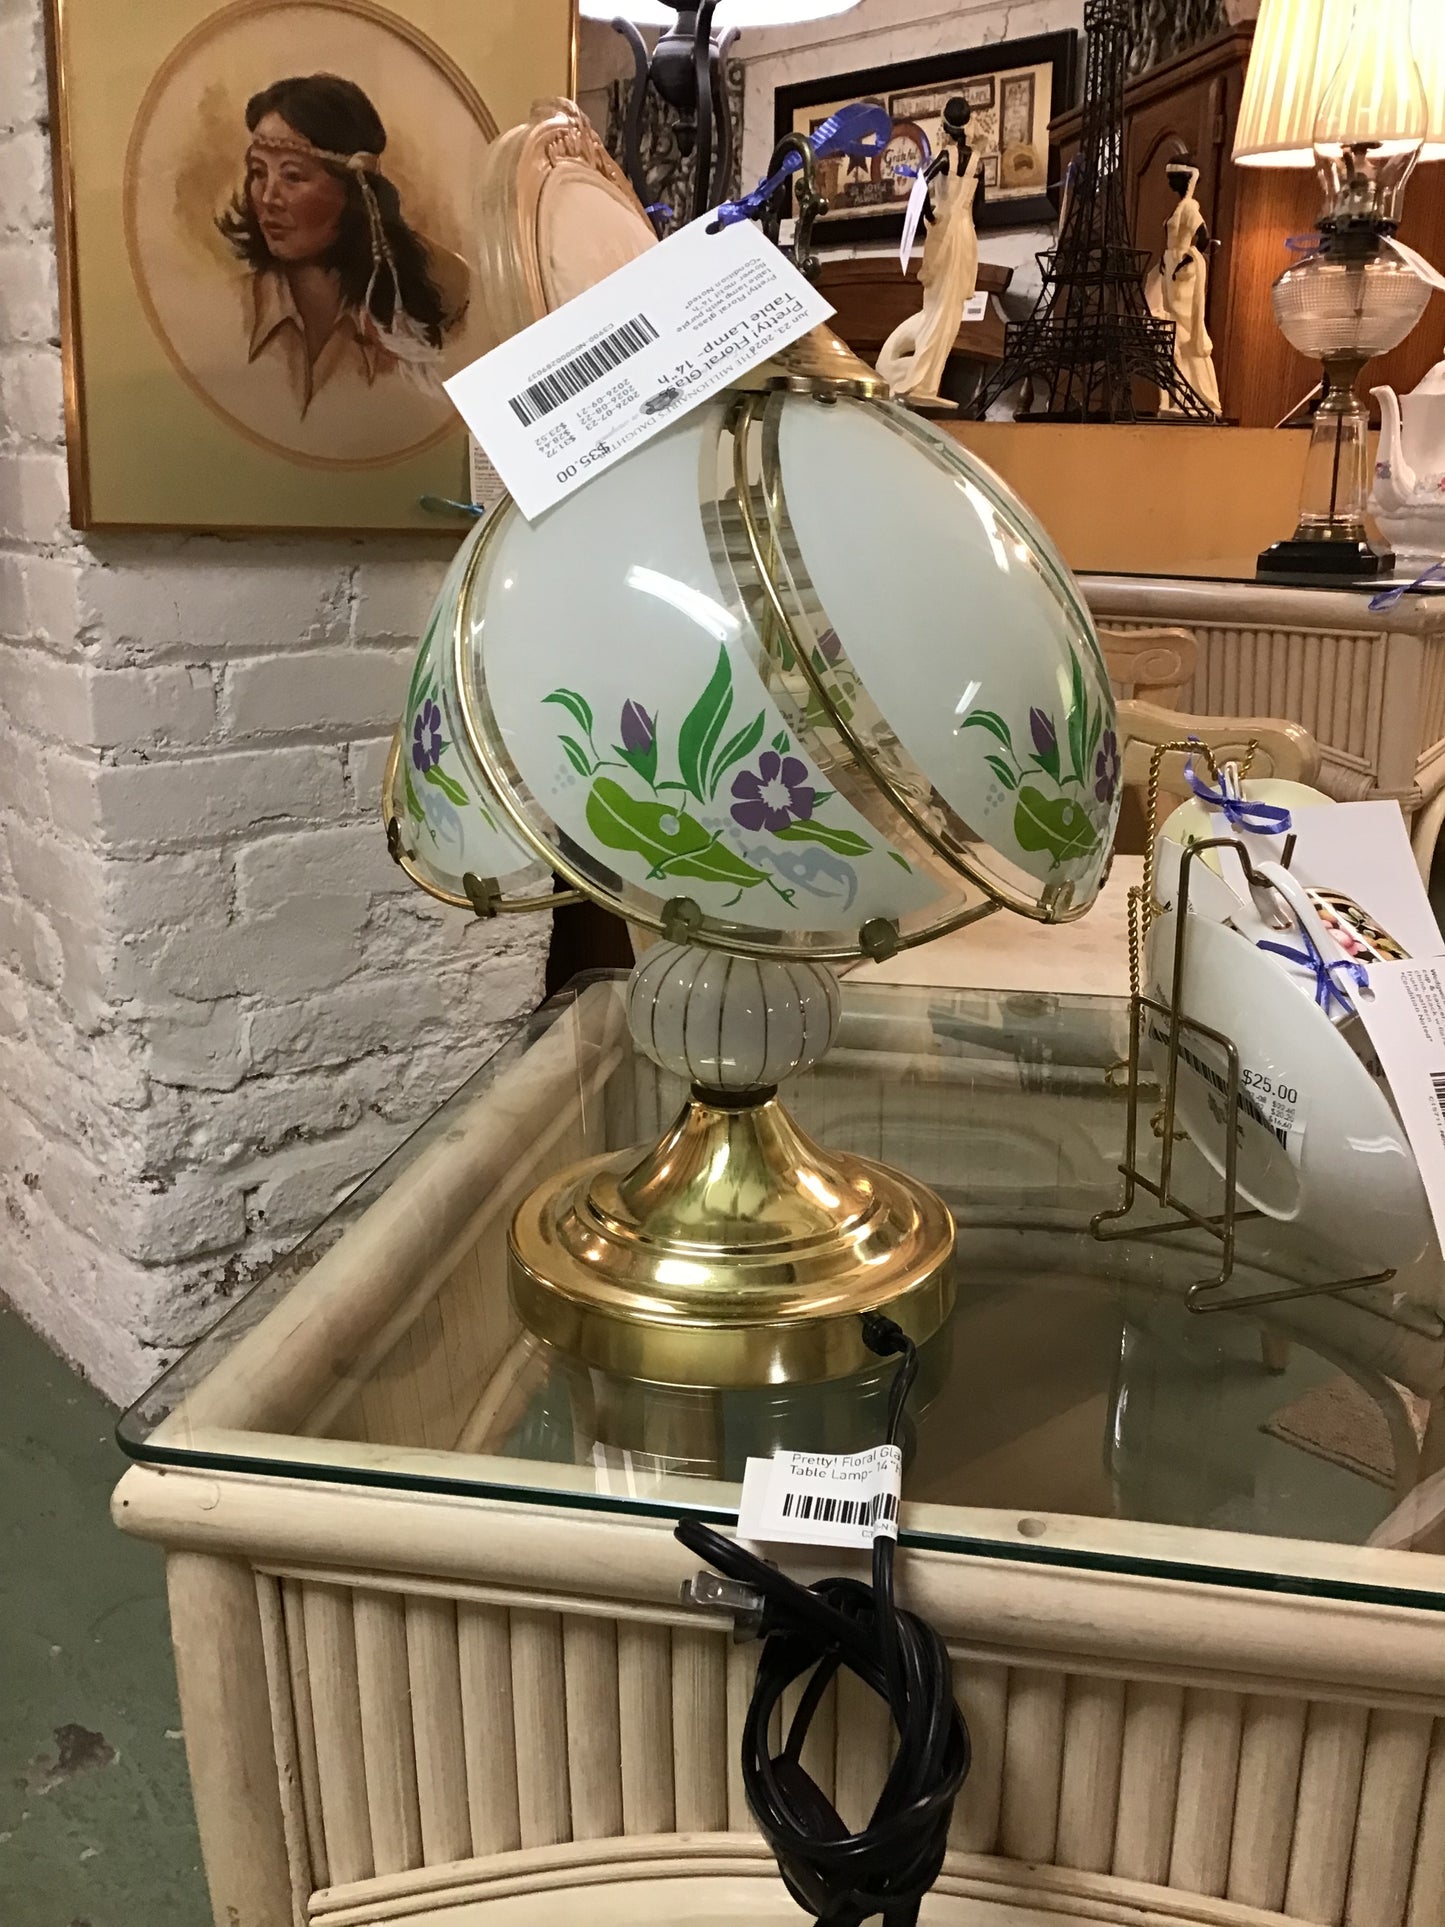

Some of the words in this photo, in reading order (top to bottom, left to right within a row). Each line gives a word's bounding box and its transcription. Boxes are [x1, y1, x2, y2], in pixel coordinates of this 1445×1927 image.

[704, 298, 724, 312] with
[750, 292, 795, 321] Table
[791, 309, 809, 323] Jun
[675, 310, 704, 332] purple
[751, 300, 803, 338] Pretty!
[703, 335, 750, 370] Floral
[556, 441, 610, 483] $35.00
[1241, 1069, 1298, 1104] $25.00
[792, 1453, 838, 1469] Pretty!
[842, 1449, 877, 1467] Floral
[790, 1464, 828, 1478] Table
[831, 1469, 873, 1483] Lamp-
